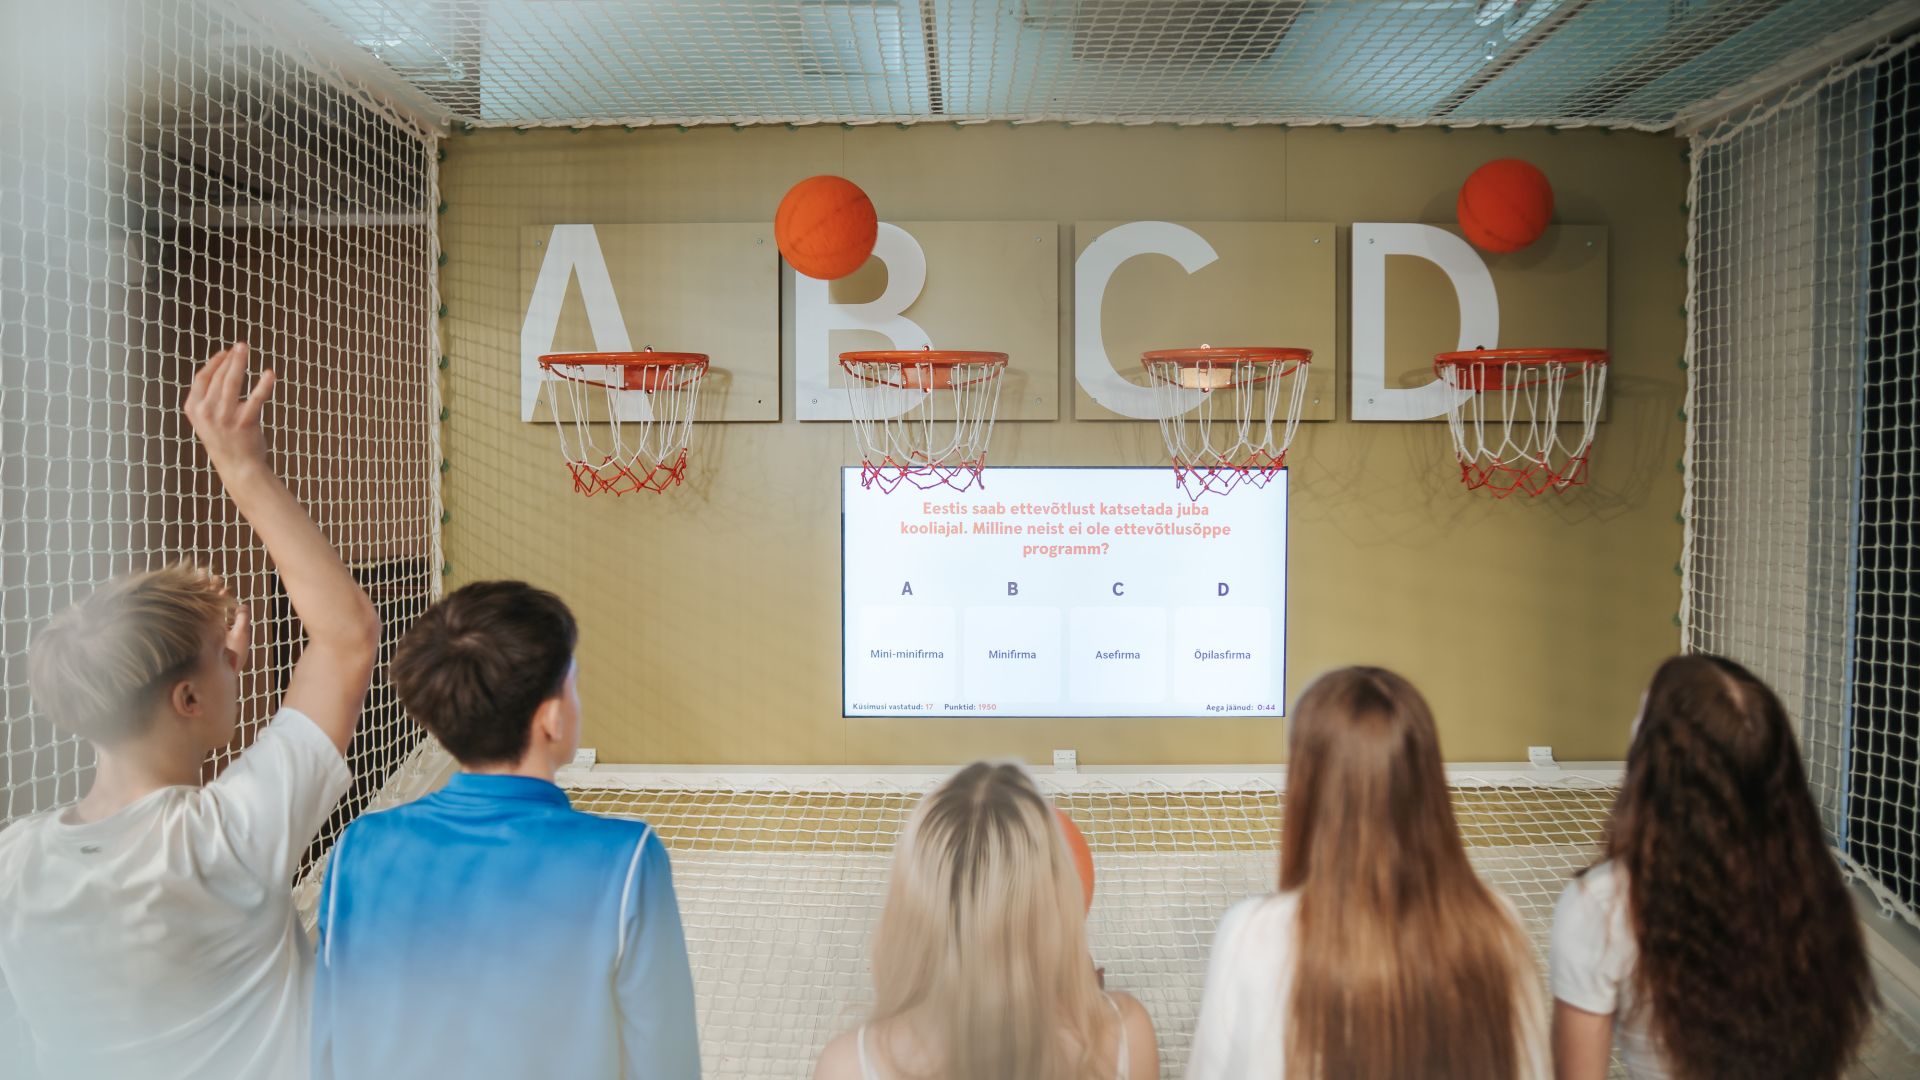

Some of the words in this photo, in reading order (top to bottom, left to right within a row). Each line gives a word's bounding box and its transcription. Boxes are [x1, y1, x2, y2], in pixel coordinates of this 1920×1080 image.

[521, 223, 655, 421] A
[796, 222, 936, 420] B
[1075, 221, 1219, 420] C
[1352, 223, 1500, 421] D
[922, 501, 968, 516] Eestis
[972, 501, 1007, 516] saab
[1010, 501, 1096, 516] ettevõtlust
[1099, 501, 1174, 516] katsetada
[1175, 502, 1209, 519] juba
[900, 520, 968, 538] kooliajal.
[972, 521, 1023, 535] Milline
[1027, 521, 1065, 535] neist
[1068, 521, 1083, 535] ei
[1086, 521, 1111, 536] ole
[1114, 522, 1232, 539] ettevõtlusõppe
[1022, 542, 1110, 558] programm?
[901, 581, 914, 597] A
[1007, 581, 1019, 597] B
[1112, 581, 1125, 597] C
[1217, 582, 1230, 597] D
[870, 648, 945, 660] Mini-minifirma
[988, 649, 1037, 661] Minifirma
[1095, 649, 1141, 661] Asefirma
[1193, 648, 1251, 662] Õpilasfirma
[853, 703, 887, 712] Küsimusi
[888, 703, 924, 712] vastatud:
[925, 703, 934, 711] 17
[944, 703, 976, 712] Punktid:
[978, 703, 997, 711] 1950
[1206, 703, 1224, 713] Aega
[1225, 703, 1254, 713] jäänud:
[1257, 703, 1276, 712] 0:44
